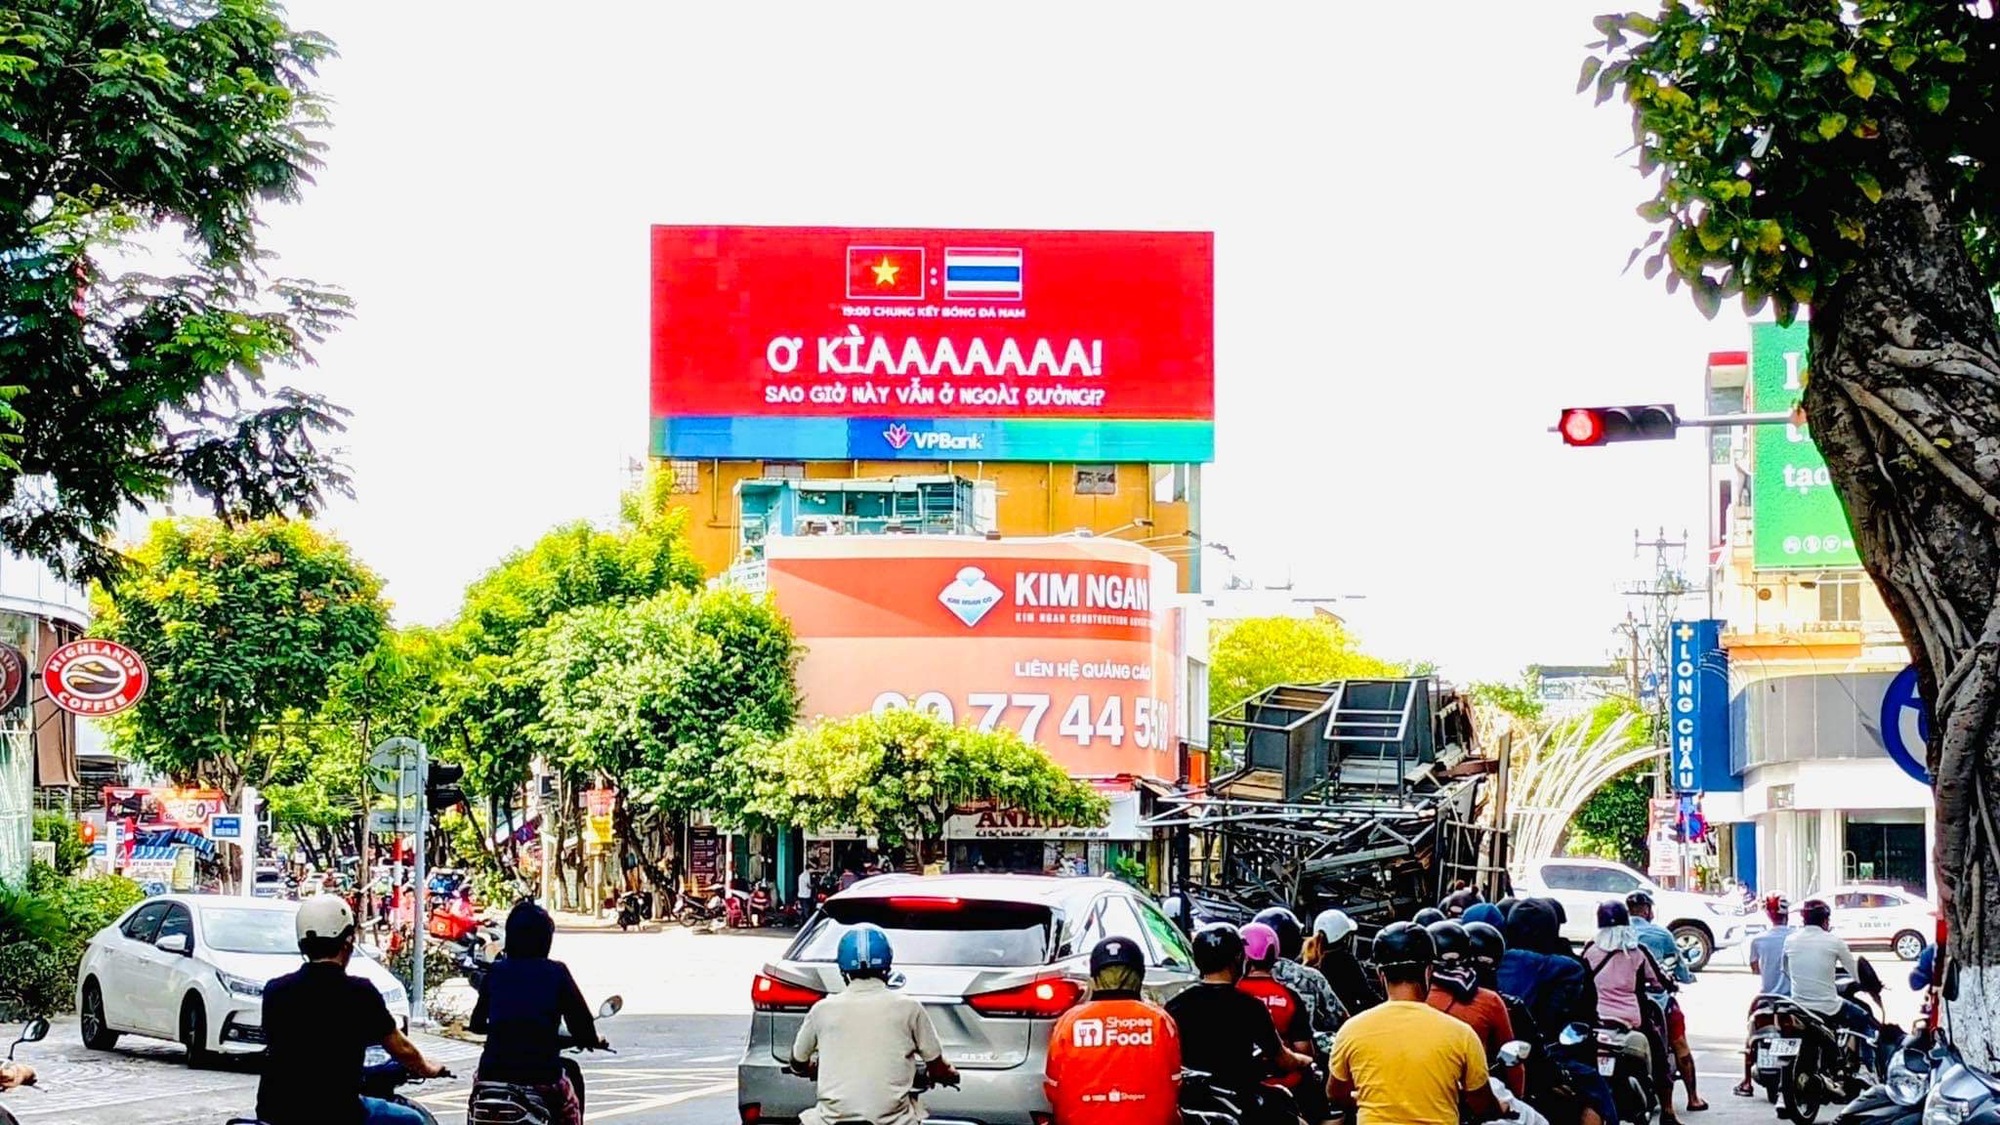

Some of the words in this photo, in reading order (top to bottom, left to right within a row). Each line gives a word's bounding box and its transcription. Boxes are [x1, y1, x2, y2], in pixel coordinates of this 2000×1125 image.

[873, 306, 915, 317] CHUNG
[999, 307, 1026, 318] NAM
[766, 336, 803, 374] Ơ
[817, 324, 1103, 376] KÌAAAAAAA!
[765, 385, 804, 403] SAO
[809, 381, 848, 403] GIỜ
[852, 381, 890, 404] NÀY
[896, 377, 935, 404] VẪN
[938, 382, 955, 405] Ở
[959, 383, 1020, 405] NGOÀI
[913, 431, 985, 450] VPBank
[1015, 572, 1079, 608] KIM
[1085, 573, 1149, 611] NGAN
[1015, 613, 1035, 624] KIM
[49, 642, 140, 677] HIGHLANDS
[1014, 658, 1054, 678] LIÊN
[1057, 658, 1080, 681] HỆ
[1081, 659, 1131, 680] QUẢNG
[1677, 644, 1694, 713] LONG
[57, 690, 127, 712] COFFEE
[968, 693, 1050, 745] 77
[1059, 695, 1124, 747] 44
[1677, 718, 1694, 788] CHÂU
[1106, 1016, 1153, 1030] Shopee
[1105, 1027, 1153, 1047] Food
